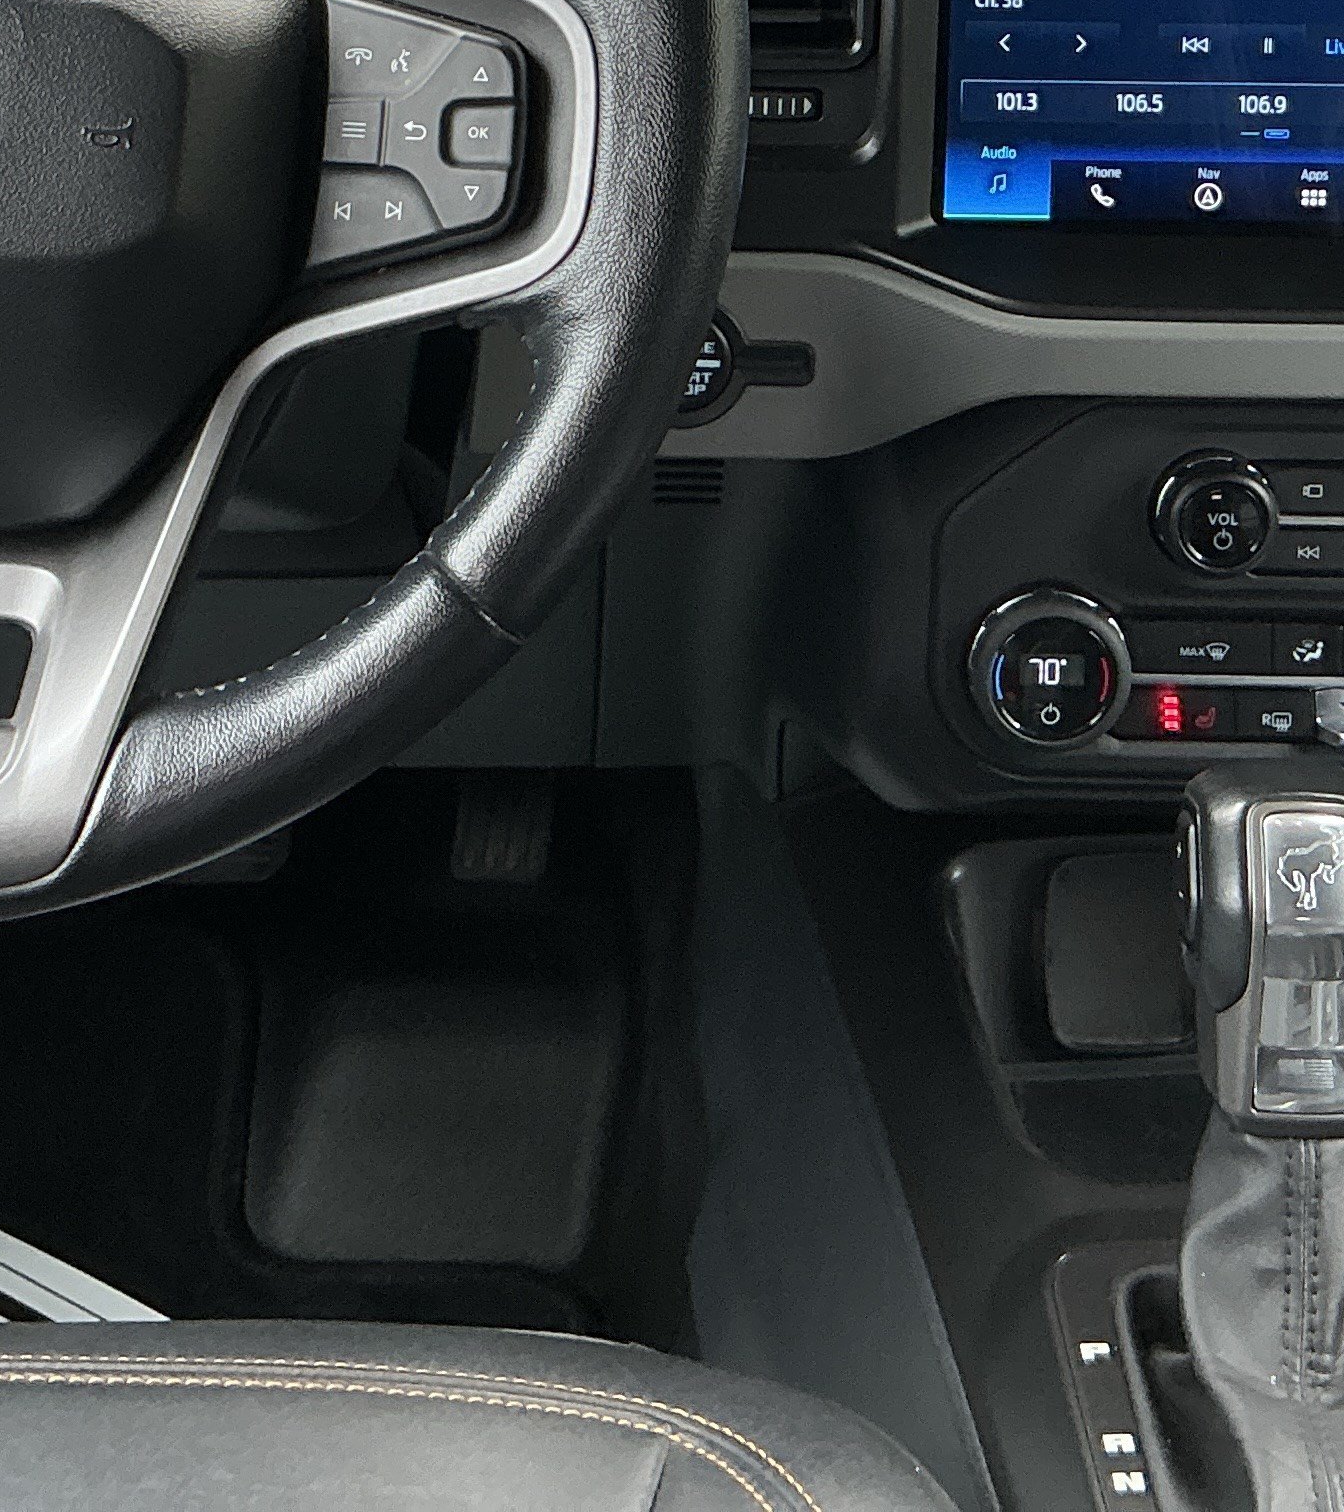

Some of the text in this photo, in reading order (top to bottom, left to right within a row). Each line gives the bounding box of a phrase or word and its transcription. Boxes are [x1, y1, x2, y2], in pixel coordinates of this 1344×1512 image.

[996, 92, 1038, 111] 101.3
[1116, 93, 1164, 113] 106.5
[1238, 94, 1288, 115] 106.9
[468, 126, 489, 140] OK
[981, 145, 1017, 160] Audio
[1085, 165, 1122, 179] Phone
[1197, 167, 1221, 180] Nav
[1300, 168, 1329, 183] Apps
[1207, 512, 1239, 527] VOL
[1179, 646, 1205, 657] MAX
[1111, 1471, 1147, 1496] N
